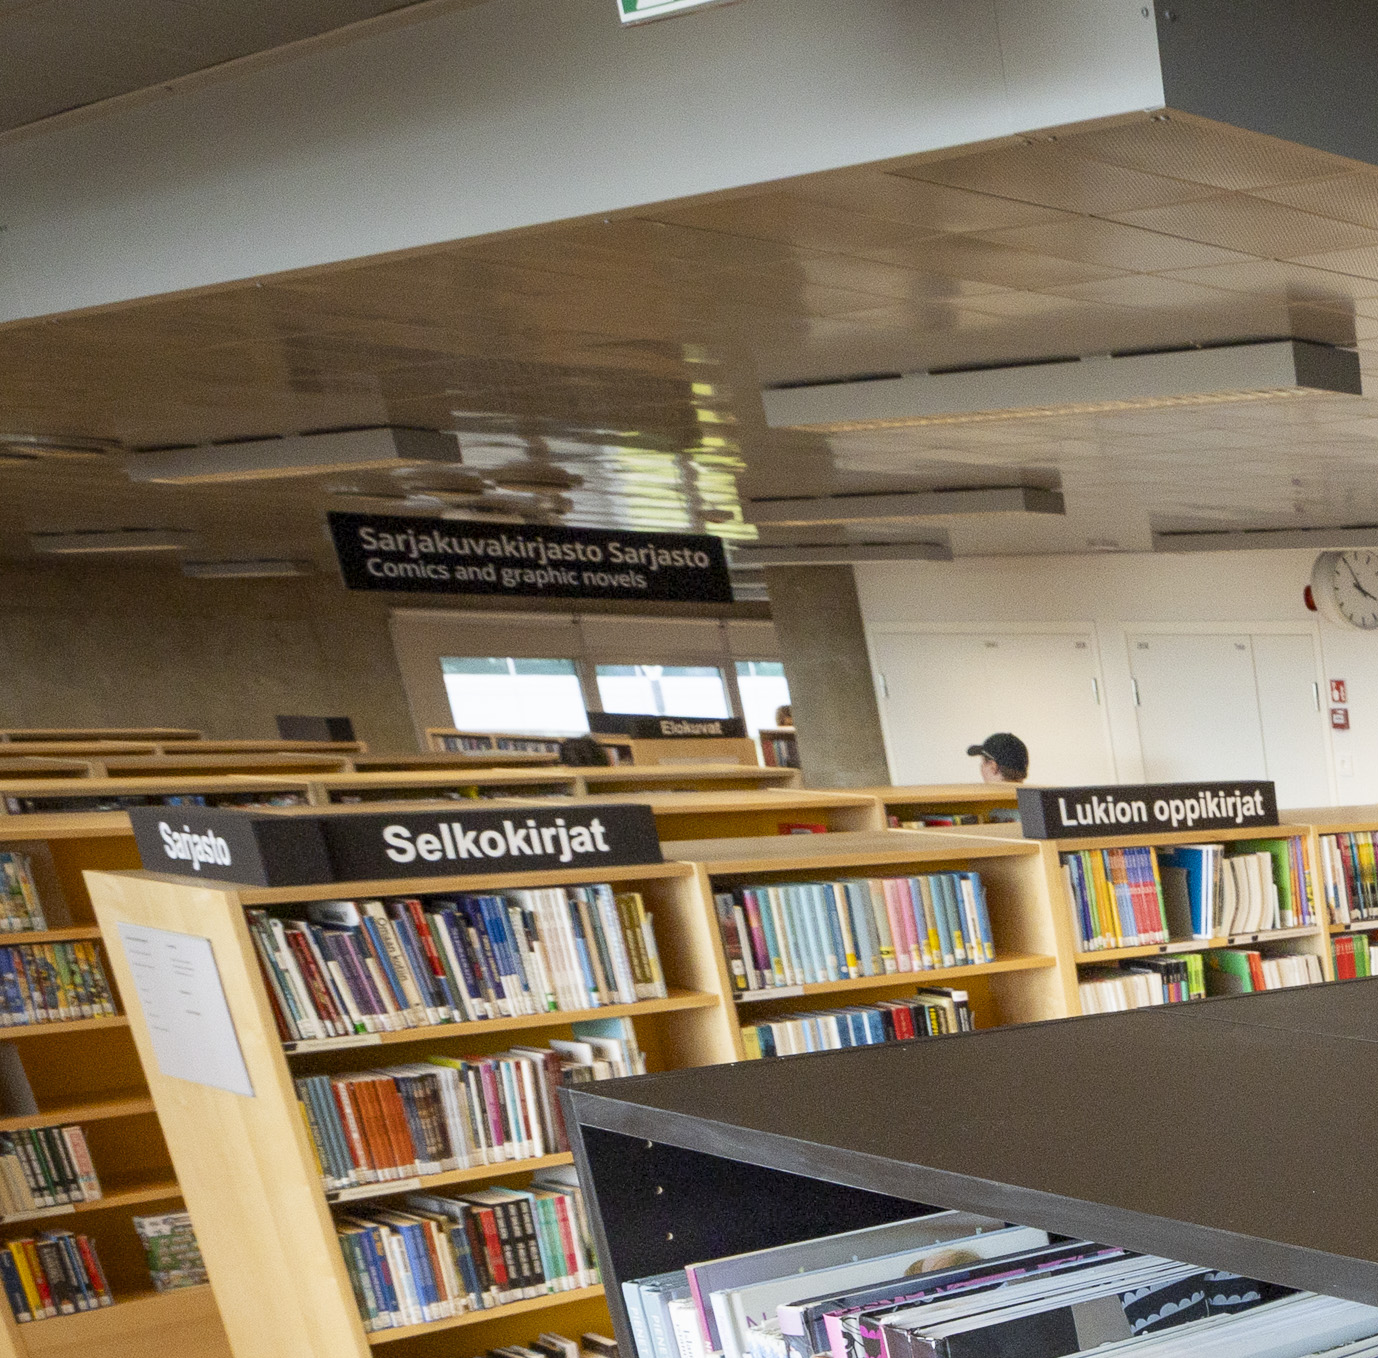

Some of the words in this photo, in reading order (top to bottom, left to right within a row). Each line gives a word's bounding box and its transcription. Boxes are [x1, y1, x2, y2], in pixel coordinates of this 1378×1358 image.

[359, 527, 603, 565] Sarjakuvakirjasto
[610, 542, 710, 570] Sarjasto
[367, 558, 449, 580] Comics
[455, 562, 496, 582] and
[502, 566, 577, 588] graphic
[583, 569, 647, 589] novels
[660, 719, 723, 736] Elokuvat
[1058, 797, 1147, 827] Lukion
[1154, 790, 1265, 827] oppikirjat
[158, 821, 232, 870] Sarjasto
[382, 817, 611, 863] Selkokirjat
[632, 1307, 649, 1354] PIENET
